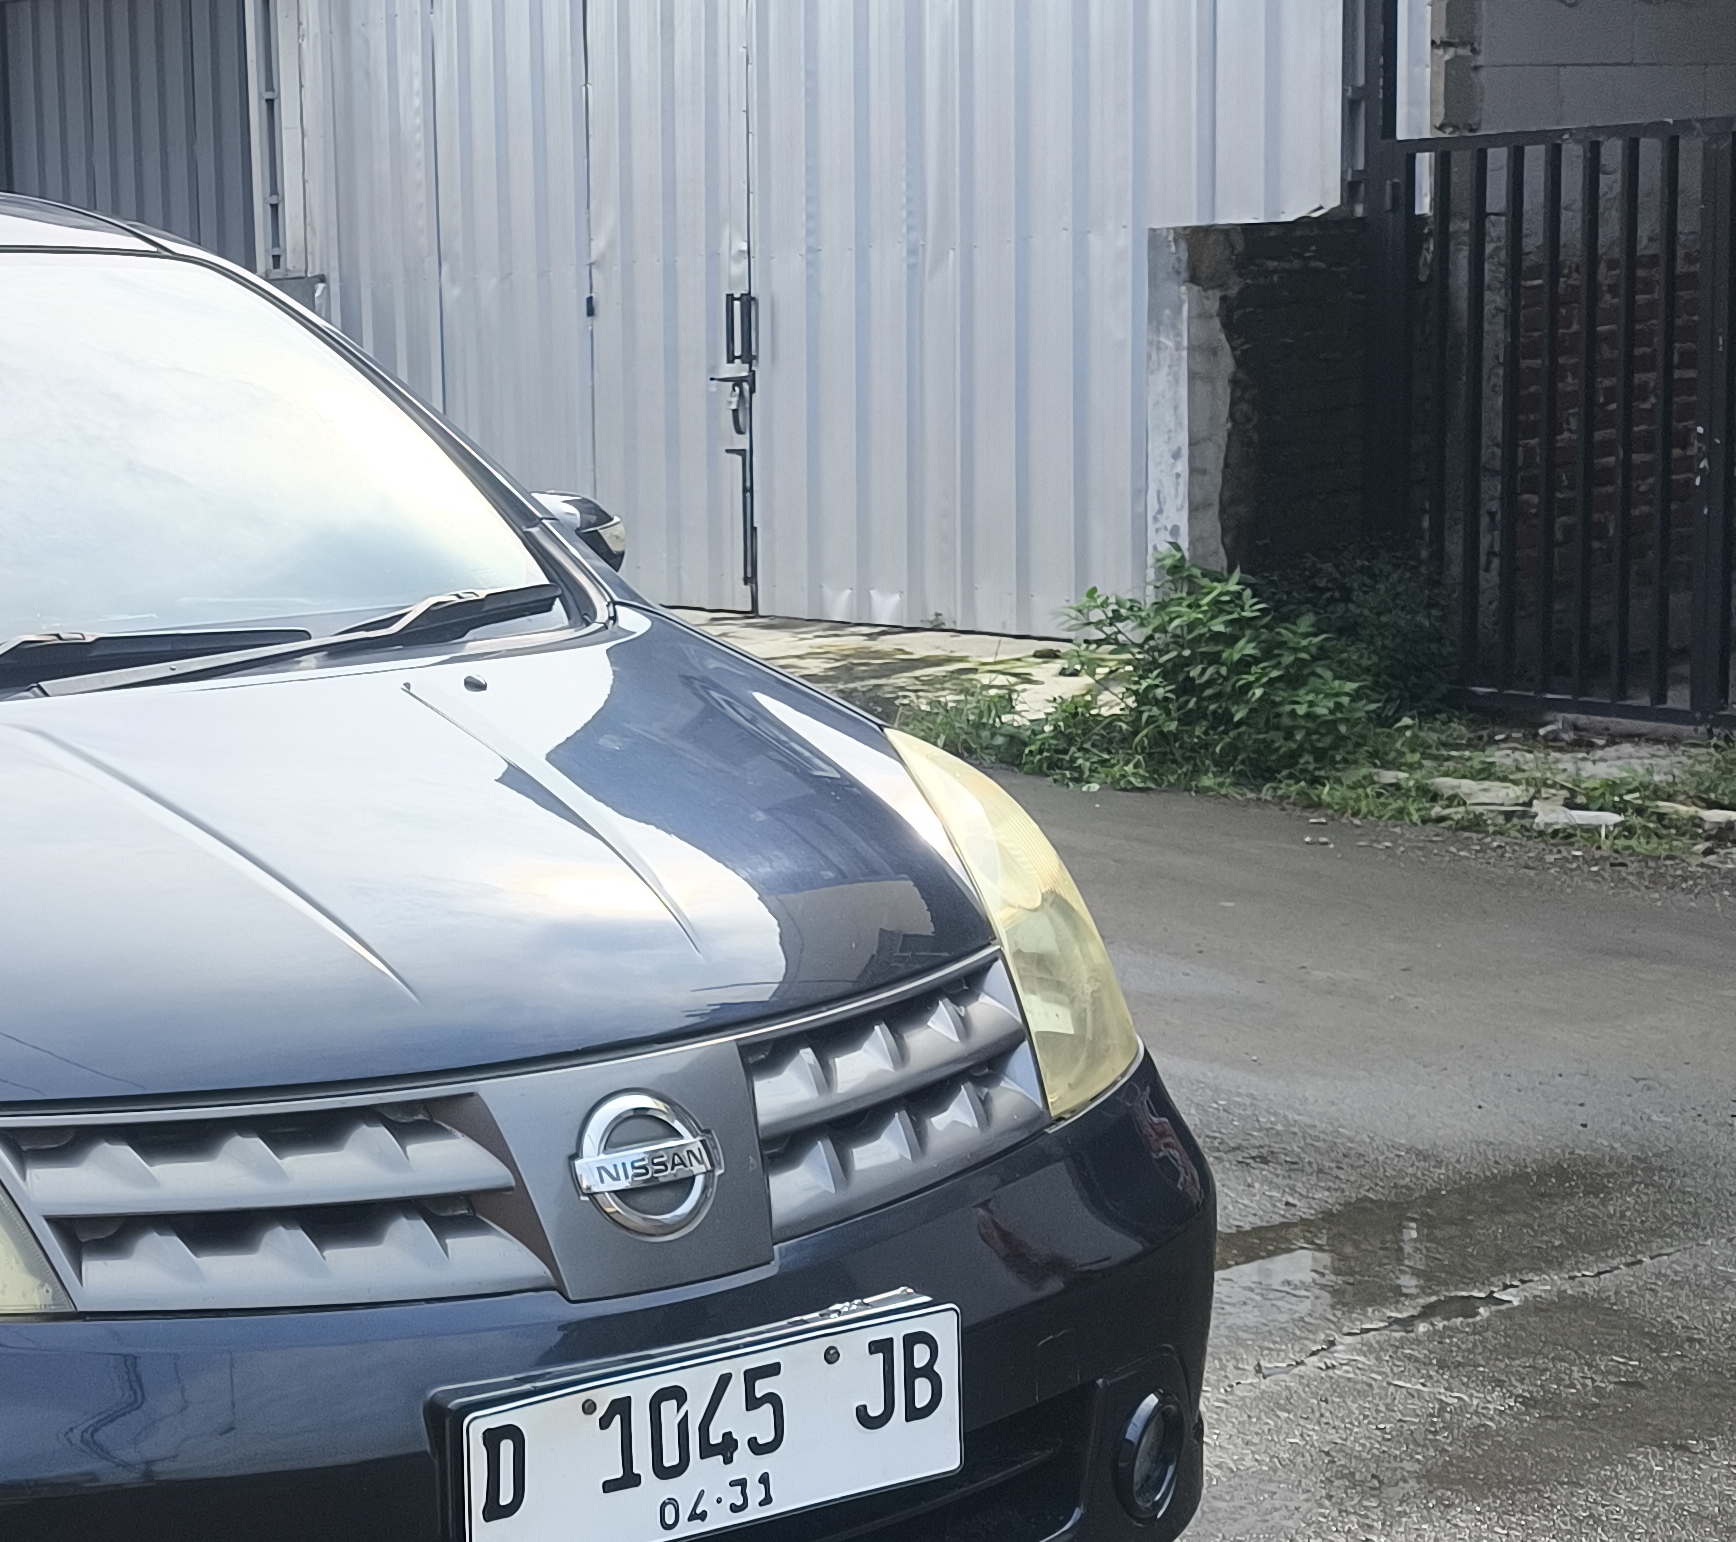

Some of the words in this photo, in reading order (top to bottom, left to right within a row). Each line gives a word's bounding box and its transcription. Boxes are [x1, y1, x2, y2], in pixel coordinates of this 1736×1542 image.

[596, 1146, 703, 1185] NISSAN
[481, 1424, 526, 1522] D
[598, 1361, 785, 1494] 1045
[855, 1330, 944, 1430] JB
